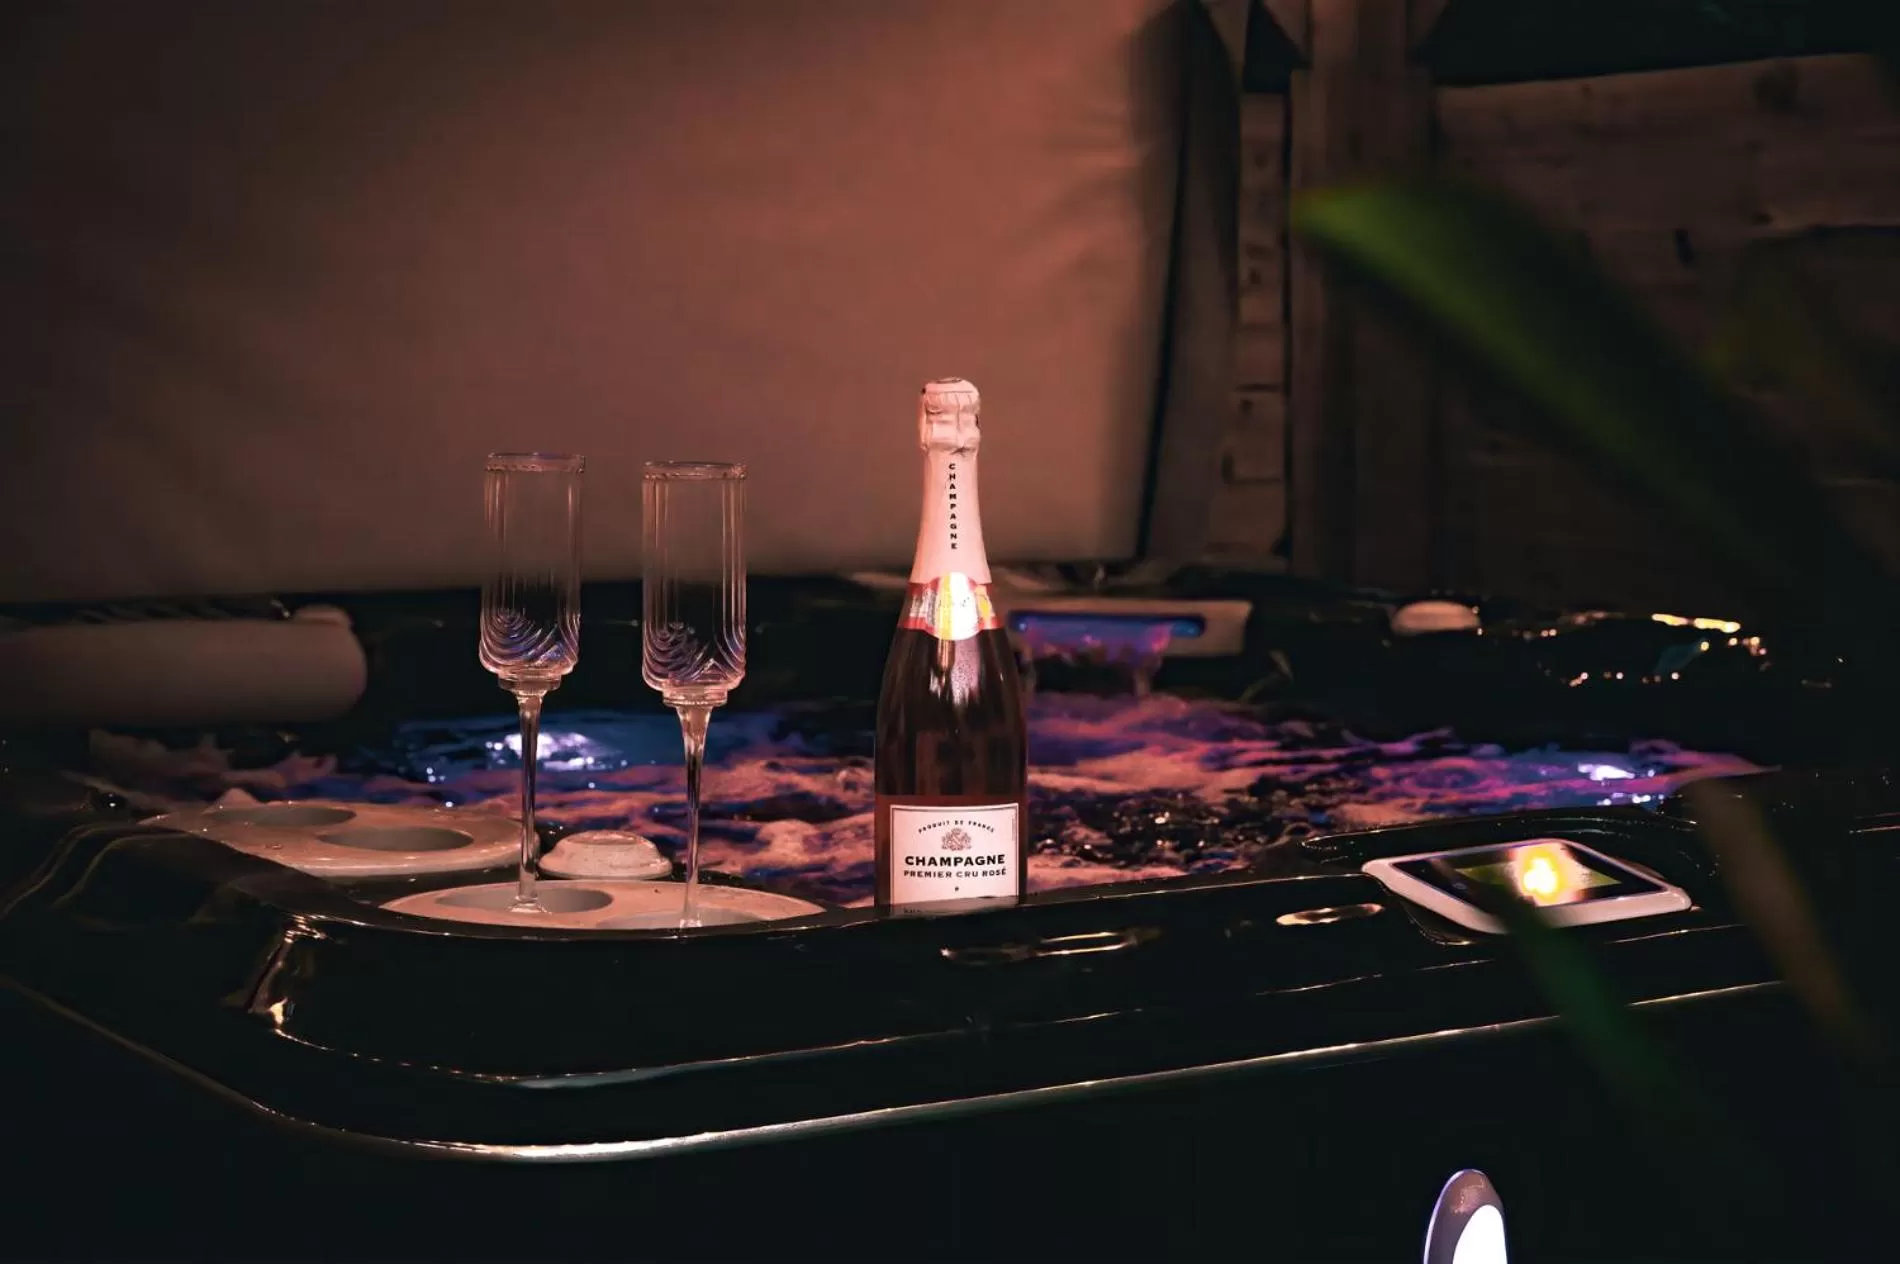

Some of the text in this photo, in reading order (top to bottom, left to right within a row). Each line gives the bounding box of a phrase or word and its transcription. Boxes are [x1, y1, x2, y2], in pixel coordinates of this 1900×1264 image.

[948, 463, 957, 550] CHAMPAGNE
[918, 820, 950, 833] PRODUIT
[968, 820, 995, 833] FRANCE
[905, 854, 1005, 867] CHAMPAGNE
[904, 867, 1006, 878] PREMIER CRU ROSÉ
